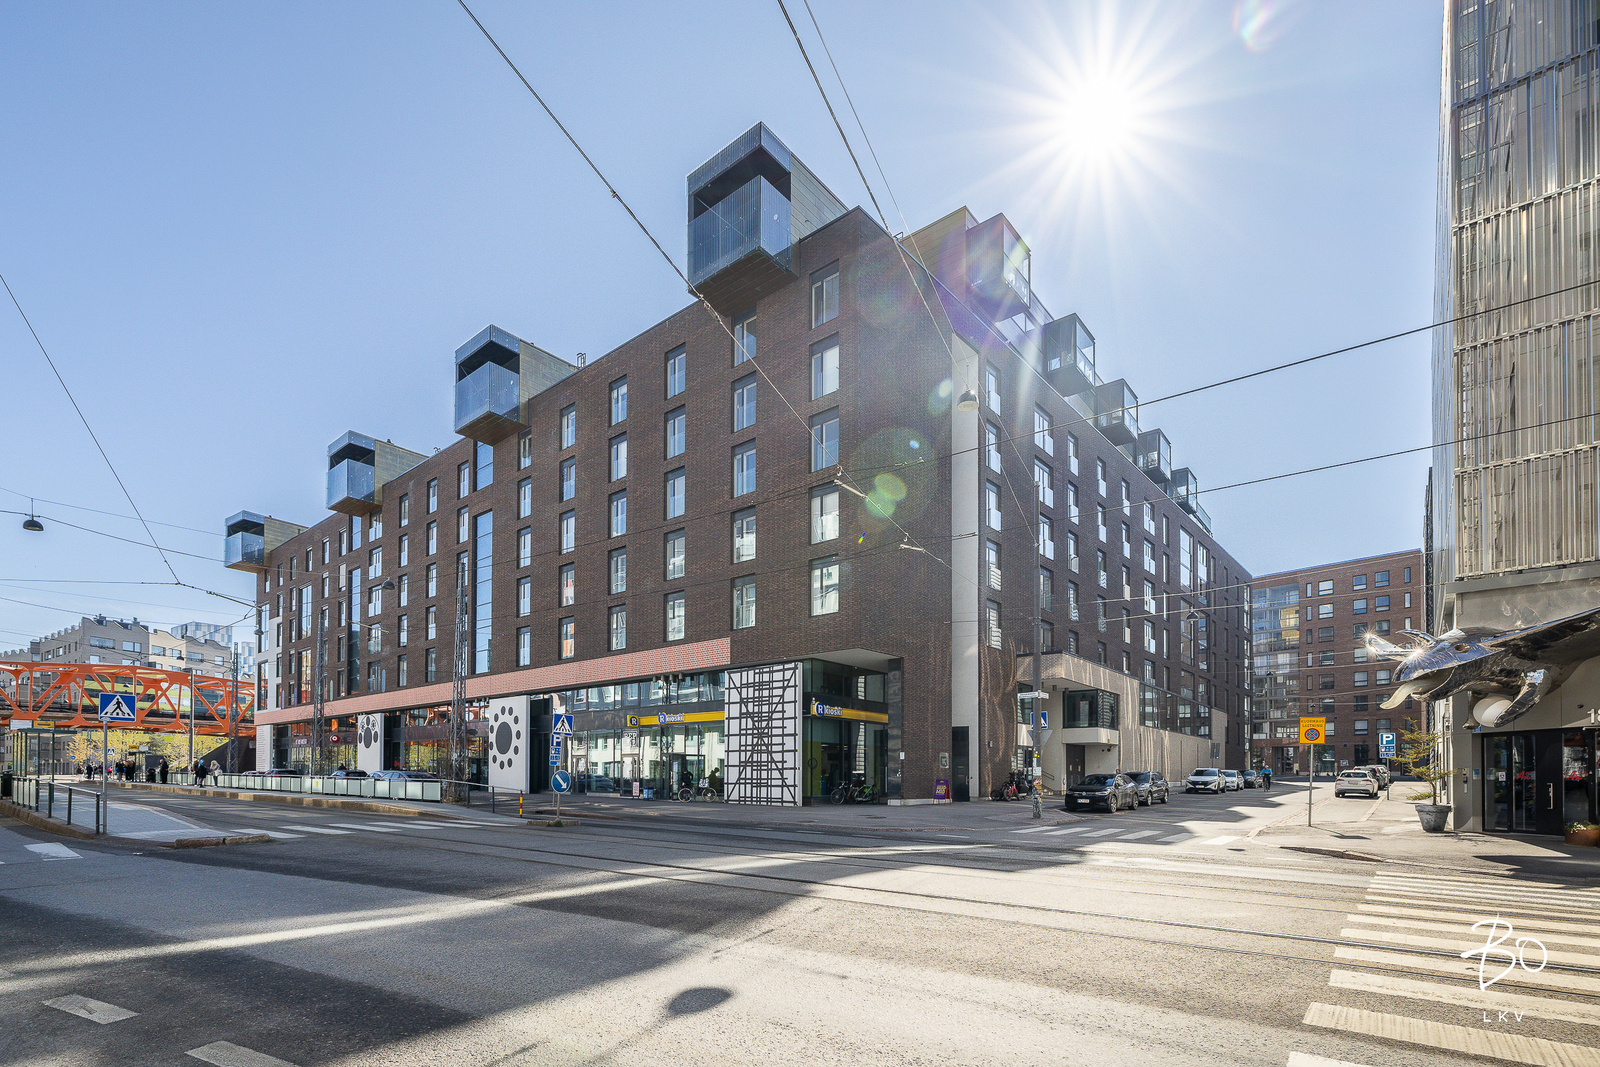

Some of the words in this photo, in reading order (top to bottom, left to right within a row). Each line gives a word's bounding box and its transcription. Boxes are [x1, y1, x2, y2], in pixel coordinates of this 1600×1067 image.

[824, 704, 843, 716] kioski
[631, 717, 637, 725] R
[665, 713, 684, 722] kioski
[553, 734, 562, 746] P
[1383, 735, 1393, 745] P
